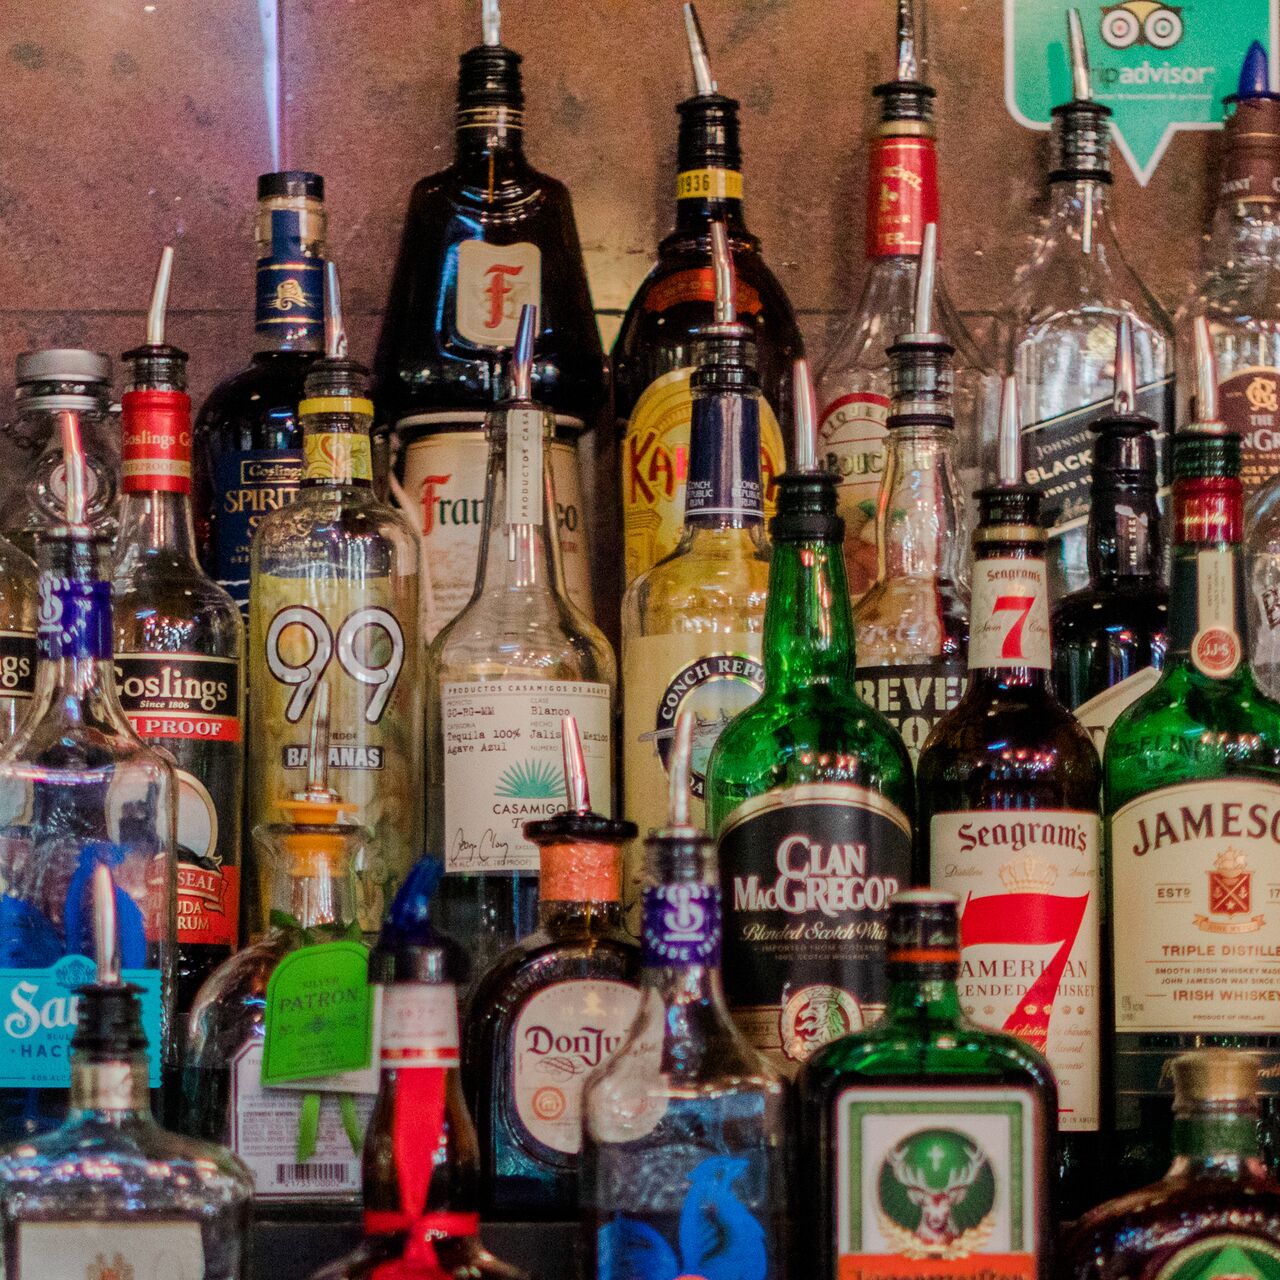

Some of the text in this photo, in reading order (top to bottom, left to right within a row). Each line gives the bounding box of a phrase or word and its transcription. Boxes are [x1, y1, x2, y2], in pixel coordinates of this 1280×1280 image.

[625, 432, 776, 504] KAA
[1024, 450, 1094, 485] BLACK
[521, 447, 530, 518] PRODUCTOS
[223, 487, 300, 513] SPIRIT
[420, 473, 579, 537] Franco
[987, 567, 1042, 584] Seagram's
[992, 595, 1037, 660] 7
[266, 605, 405, 724] 99
[448, 685, 503, 694] PRODUCTOS
[508, 684, 568, 694] CASAMIGOS
[661, 658, 766, 721] CONCH REPU
[856, 677, 968, 712] REVE
[140, 700, 190, 710] Since 1806
[531, 706, 571, 717] Blanco
[146, 719, 222, 736] PROOF
[447, 730, 486, 743] Tequila
[493, 729, 521, 740] 100%
[529, 730, 563, 740] Jalis
[286, 746, 381, 768] BAANAS
[447, 742, 508, 756] Agave Azul
[492, 803, 568, 816] CASAMIGO
[958, 819, 1088, 853] Seagram's
[776, 836, 867, 880] CLAN
[176, 873, 216, 892] SEAL
[176, 914, 211, 931] RUM
[741, 922, 804, 942] Blended
[804, 920, 857, 941] Scotch
[856, 920, 889, 941] Whis
[1162, 944, 1216, 958] TRIPLE
[960, 890, 1091, 1056] 7
[961, 959, 1088, 979] AMERIAN
[1155, 967, 1192, 976] SMOOTH
[1193, 967, 1218, 976] IRISH
[1220, 967, 1259, 976] WHISKEY
[957, 983, 1029, 997] LENDED
[1160, 976, 1184, 986] JOHN
[1185, 976, 1229, 986] JAMESON
[1172, 990, 1215, 1001] IRISH
